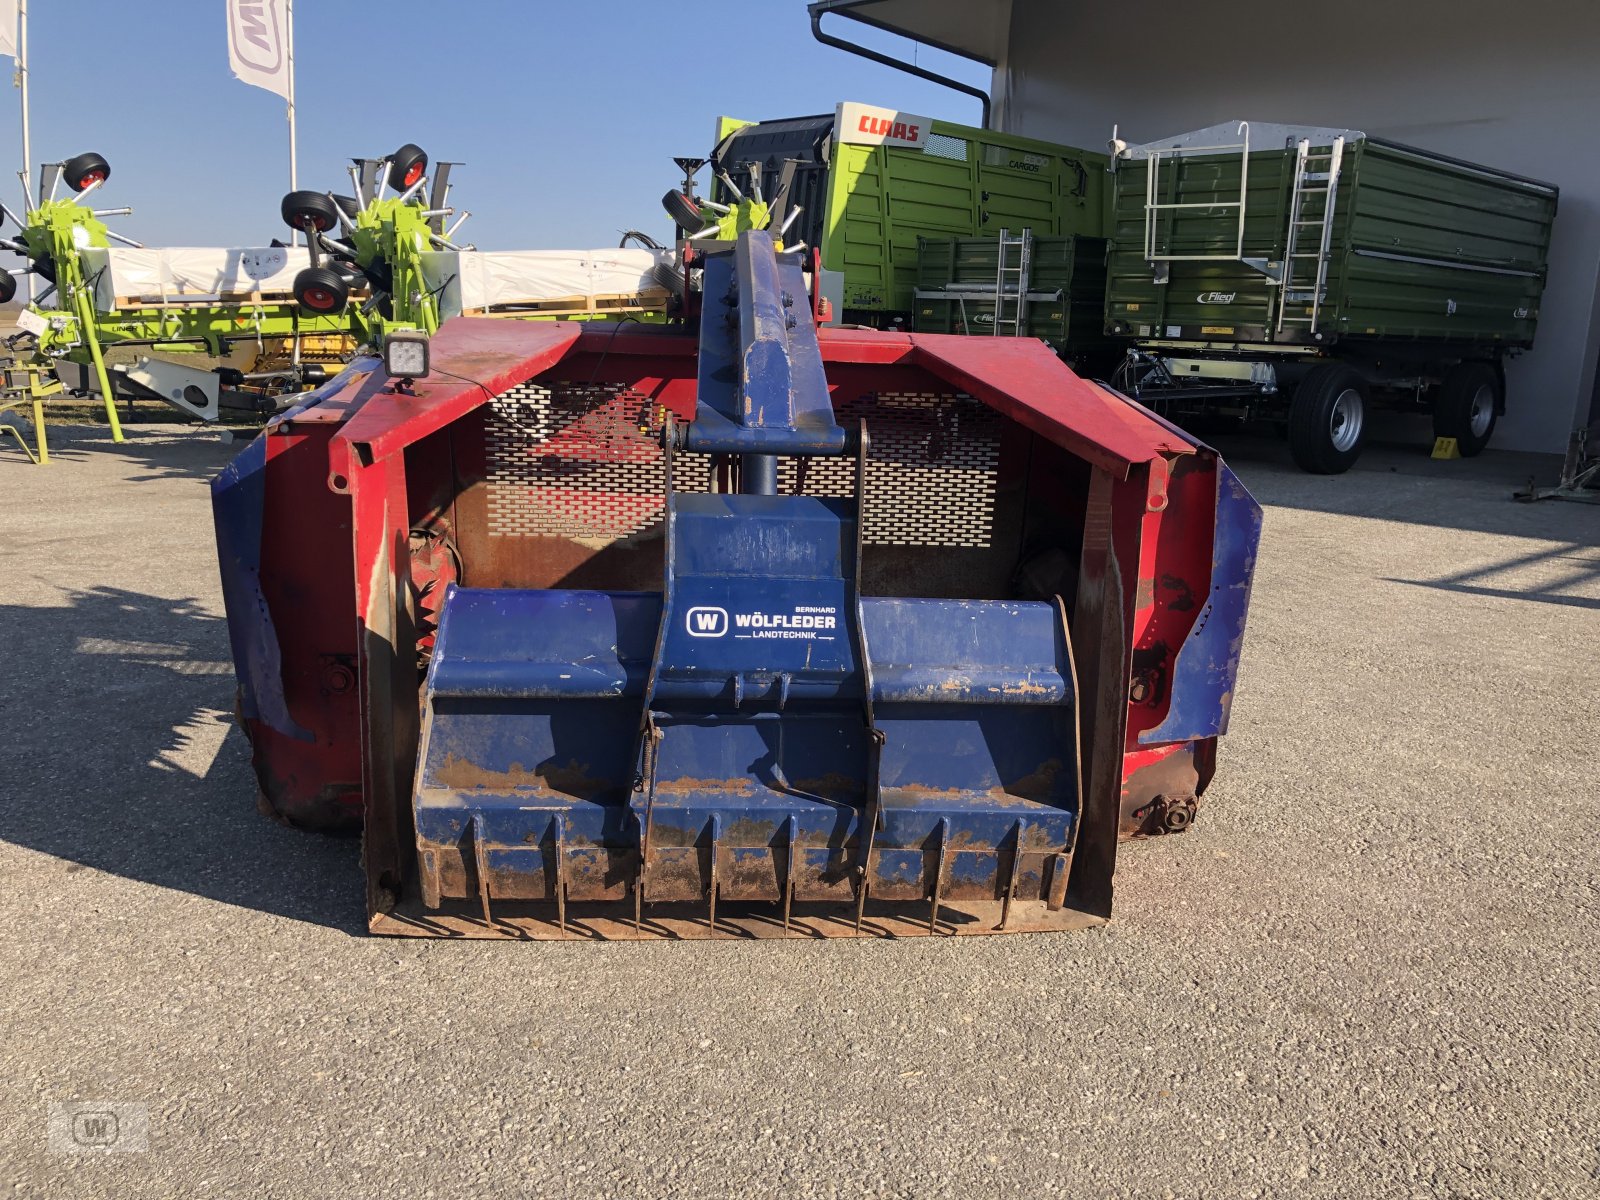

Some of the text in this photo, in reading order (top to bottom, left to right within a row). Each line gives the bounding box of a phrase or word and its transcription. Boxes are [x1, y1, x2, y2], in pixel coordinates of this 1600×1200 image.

[858, 115, 919, 142] CLAAS
[1009, 160, 1039, 172] CARGOS
[1208, 291, 1236, 303] Fliegl
[795, 606, 836, 614] BERNHARD
[696, 613, 718, 631] W
[735, 612, 836, 629] WÖLFLEDER
[752, 630, 817, 639] LANDTECHNIK
